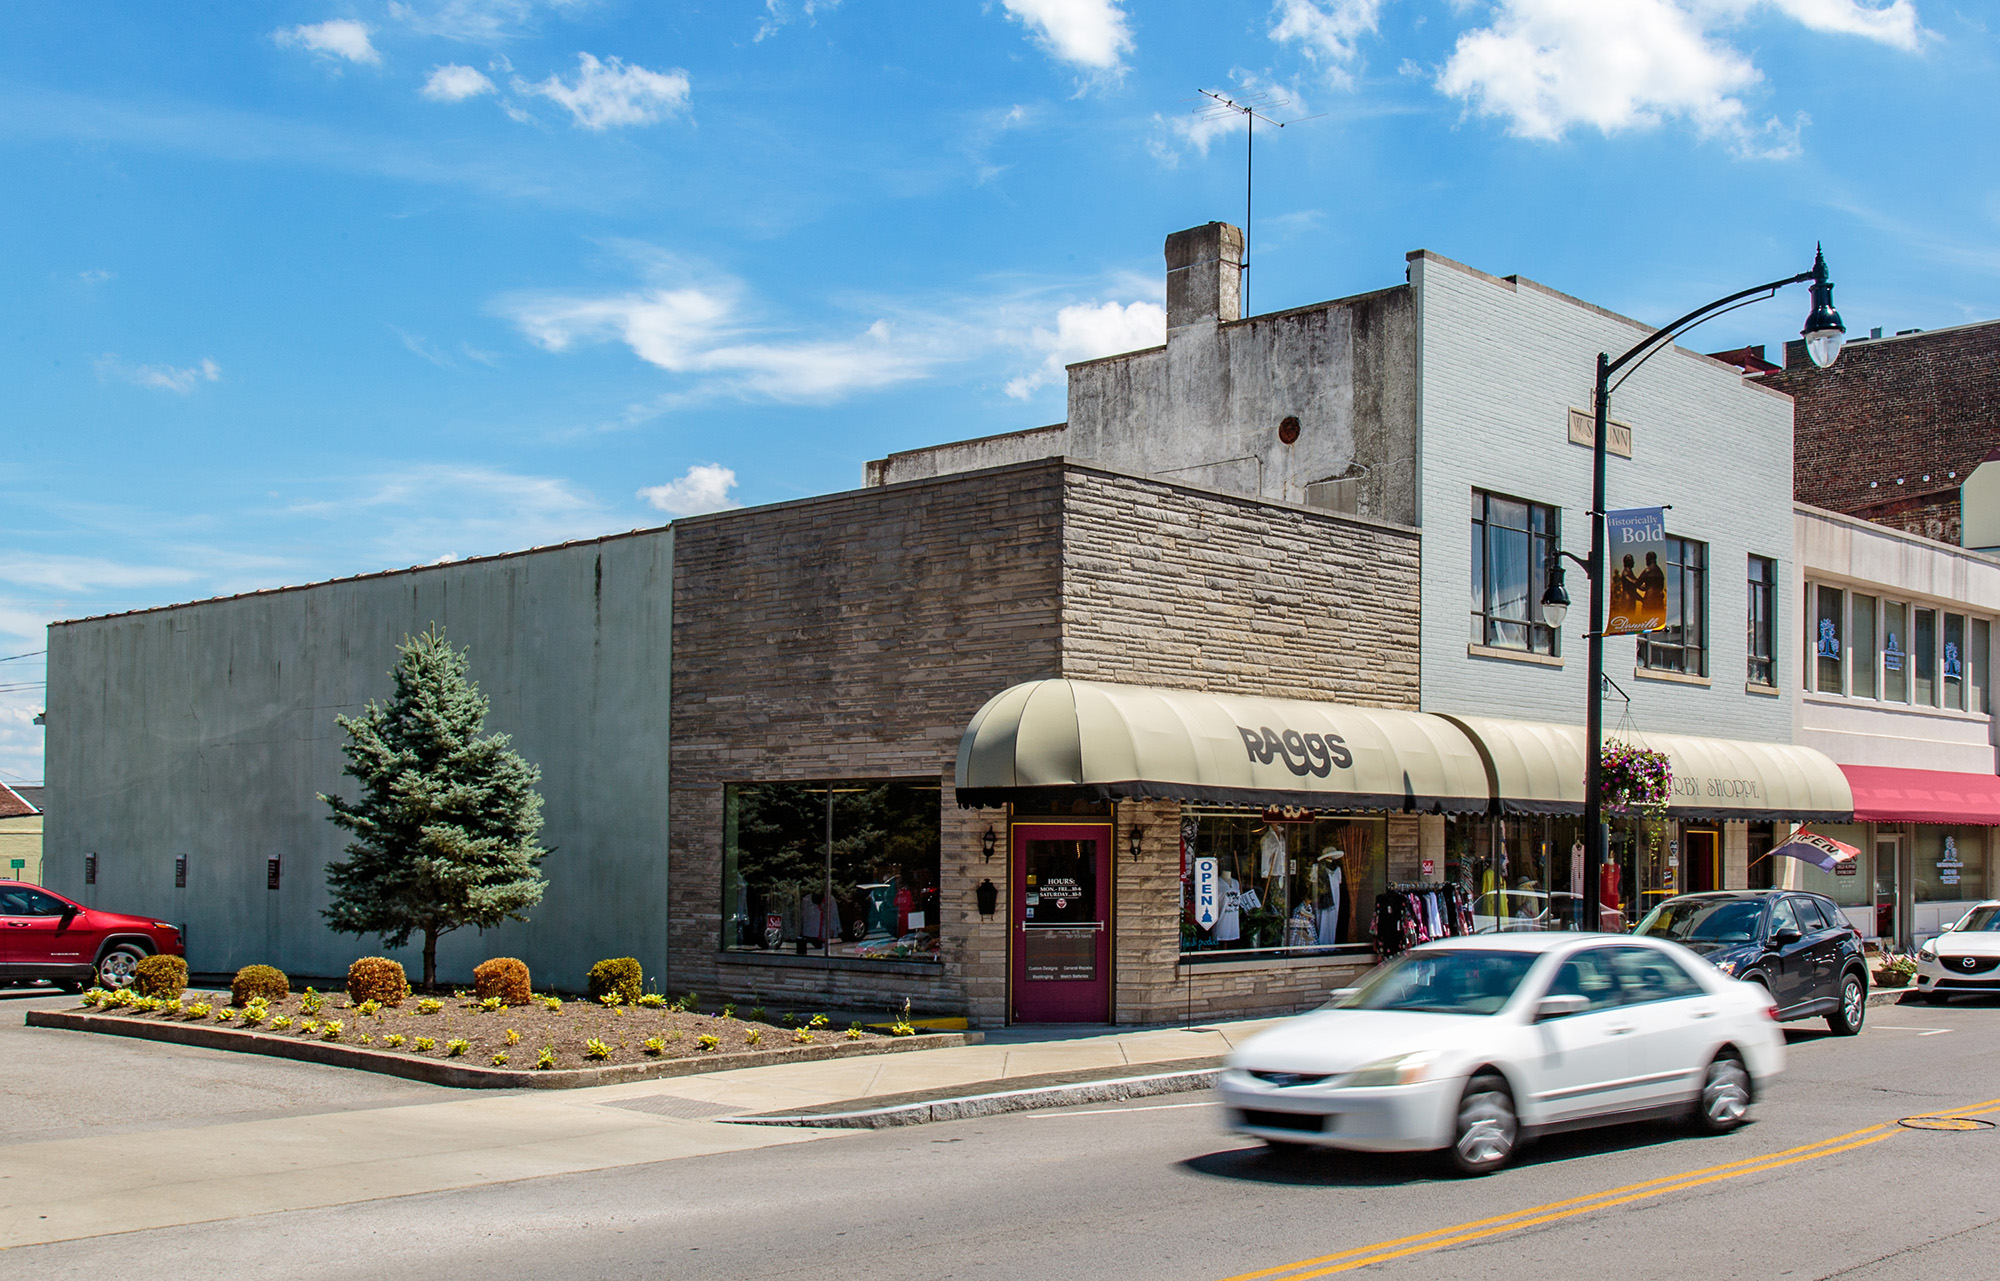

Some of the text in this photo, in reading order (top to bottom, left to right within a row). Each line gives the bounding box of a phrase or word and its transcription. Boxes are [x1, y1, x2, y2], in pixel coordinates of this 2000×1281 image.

[1608, 514, 1658, 527] Historically
[1621, 523, 1664, 544] Bold
[1047, 877, 1076, 885] HOURS:
[1200, 861, 1213, 906] OPEN
